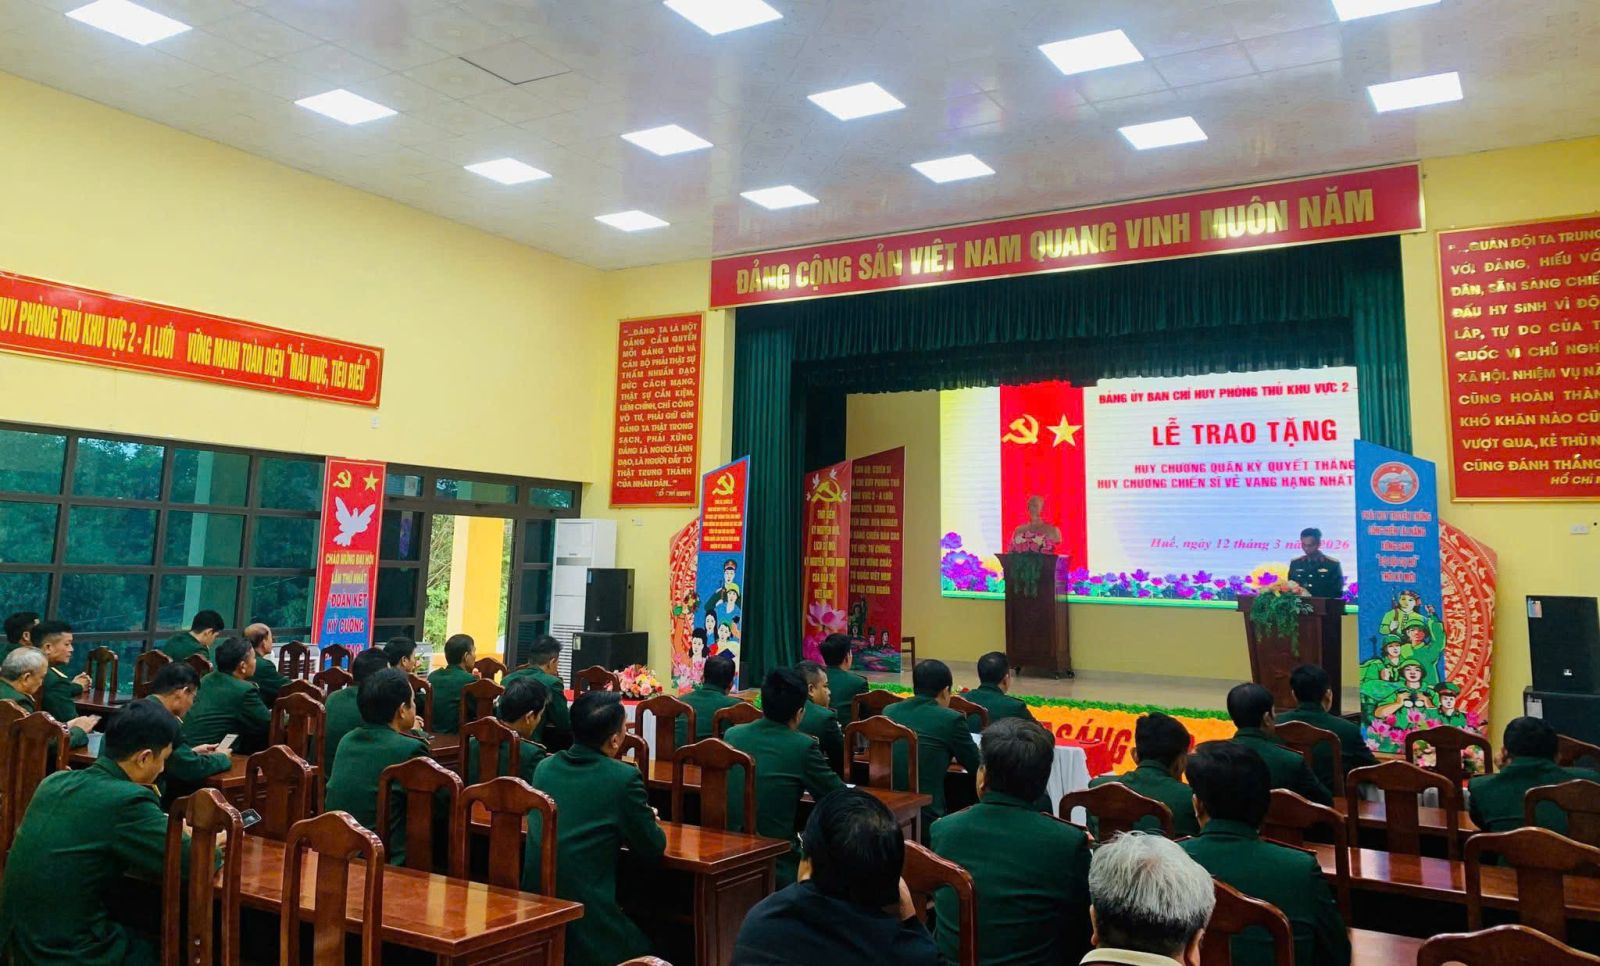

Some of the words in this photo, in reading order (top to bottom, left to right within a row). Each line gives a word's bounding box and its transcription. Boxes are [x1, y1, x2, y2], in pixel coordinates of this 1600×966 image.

[737, 258, 789, 294] ĐẢNG
[796, 254, 852, 291] CỘNG
[859, 244, 902, 279] SẢN
[910, 238, 957, 275] VIỆT
[964, 234, 1021, 268] NAM
[1030, 223, 1116, 263] QUANG
[1125, 213, 1190, 248] VINH
[1200, 195, 1288, 241] MUÔN
[1300, 186, 1374, 229] NĂM
[1511, 234, 1536, 249] ĐỘI
[1539, 235, 1555, 244] TA
[1451, 262, 1476, 275] VỚI
[1540, 251, 1571, 266] HIẾU
[1451, 283, 1484, 296] DÂN,
[1488, 278, 1516, 293] SẴN
[1521, 277, 1561, 290] SÀNG
[1452, 302, 1481, 318] ĐẤU
[1489, 304, 1508, 316] HY
[1515, 302, 1546, 313] SINH
[1555, 296, 1570, 310] VÌ
[1455, 327, 1485, 341] LẬP,
[1492, 325, 1509, 338] TỰ
[1518, 325, 1541, 335] DO
[1549, 318, 1582, 332] CỦA
[18, 296, 58, 339] PHÒNG
[60, 300, 82, 343] THỦ
[82, 313, 105, 347] KHU
[106, 316, 127, 357] VỰC
[128, 322, 136, 352] 2
[143, 325, 151, 355] A
[153, 322, 176, 359] LƯỚI
[187, 327, 212, 365] VỮNG
[213, 337, 241, 375] MẠNH
[242, 338, 264, 374] TOÀN
[264, 343, 284, 383] DIỆN
[309, 354, 328, 390] MỰC,
[331, 355, 347, 388] TIÊU
[1456, 345, 1499, 361] QUỐC
[1507, 345, 1520, 358] VÌ
[1528, 341, 1558, 356] CHỦ
[640, 358, 650, 369] BỘ
[679, 367, 695, 376] ĐẠO
[1458, 371, 1478, 382] XÃ
[1513, 366, 1555, 381] NHIỆM
[1561, 368, 1580, 380] VỤ
[643, 379, 666, 387] CÁCH
[1147, 391, 1169, 401] BAN
[1194, 389, 1215, 399] HUY
[1220, 384, 1258, 398] PHÒNG
[1262, 381, 1283, 396] THỦ
[1288, 384, 1311, 395] KHU
[1315, 382, 1338, 395] VỰC
[1342, 382, 1349, 392] 2
[1459, 392, 1501, 404] CŨNG
[1511, 389, 1554, 402] HOÀN
[1460, 413, 1490, 426] KHÓ
[1495, 414, 1536, 426] KHĂN
[1540, 412, 1572, 424] NÀO
[1152, 417, 1180, 446] LỄ
[1192, 422, 1256, 444] TRAO
[1267, 417, 1337, 447] TẶNG
[1462, 437, 1499, 451] VƯỢT
[1502, 438, 1538, 449] QUA,
[1540, 432, 1558, 447] KẺ
[1561, 433, 1587, 446] THÙ
[1134, 464, 1156, 474] HUY
[1210, 461, 1243, 473] QUÂN
[1268, 458, 1309, 472] QUYẾT
[1463, 459, 1504, 471] CŨNG
[1508, 458, 1548, 471] ĐÁNH
[1097, 479, 1118, 489] HUY
[1171, 476, 1205, 488] CHIẾN
[1245, 477, 1277, 487] VANG
[1281, 476, 1315, 490] HẠNG
[1551, 472, 1569, 484] HỒ
[1572, 473, 1593, 484] CHÍ
[1183, 539, 1211, 549] ngày
[1216, 539, 1230, 548] 12
[1234, 538, 1269, 550] tháng
[1274, 539, 1281, 549] 3
[1319, 539, 1350, 549] 2026
